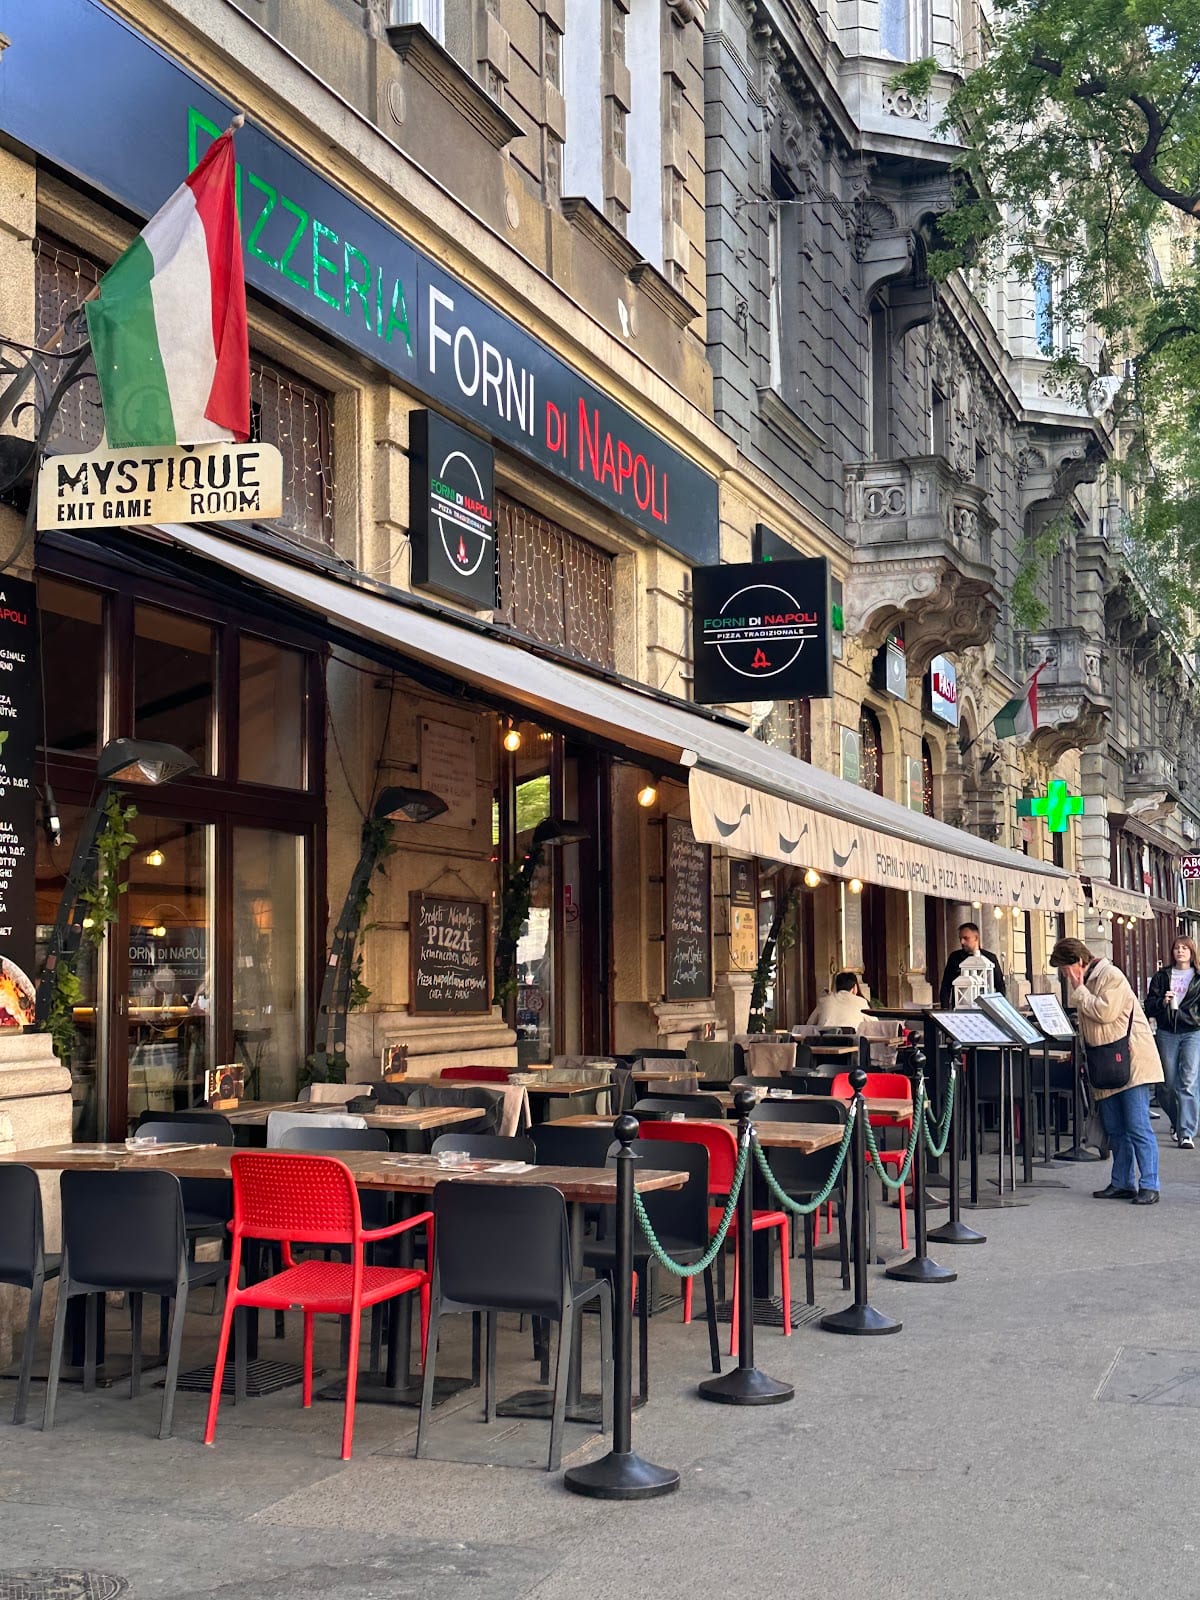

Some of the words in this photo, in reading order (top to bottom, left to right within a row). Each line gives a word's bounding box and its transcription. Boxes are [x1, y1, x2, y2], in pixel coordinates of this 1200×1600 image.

[546, 401, 567, 458] DI
[578, 397, 667, 525] NAPOLI
[57, 452, 260, 497] MYSTIQUE
[57, 502, 95, 522] EXIT
[102, 498, 152, 519] GAME
[190, 489, 260, 515] ROOM
[430, 478, 455, 500] FORNI
[455, 492, 464, 506] DI
[464, 495, 492, 521] NAPOLI
[703, 616, 745, 629] FORNI
[748, 616, 761, 626] DI
[764, 611, 817, 625] NAPOLI
[743, 628, 804, 638] TRADIZIONALE
[876, 853, 899, 878] FORNI
[906, 860, 930, 884] NAPOLI
[938, 868, 959, 890] PIZZA
[1183, 867, 1200, 878] 0-2
[427, 925, 473, 951] PIZZA
[158, 948, 168, 960] DI
